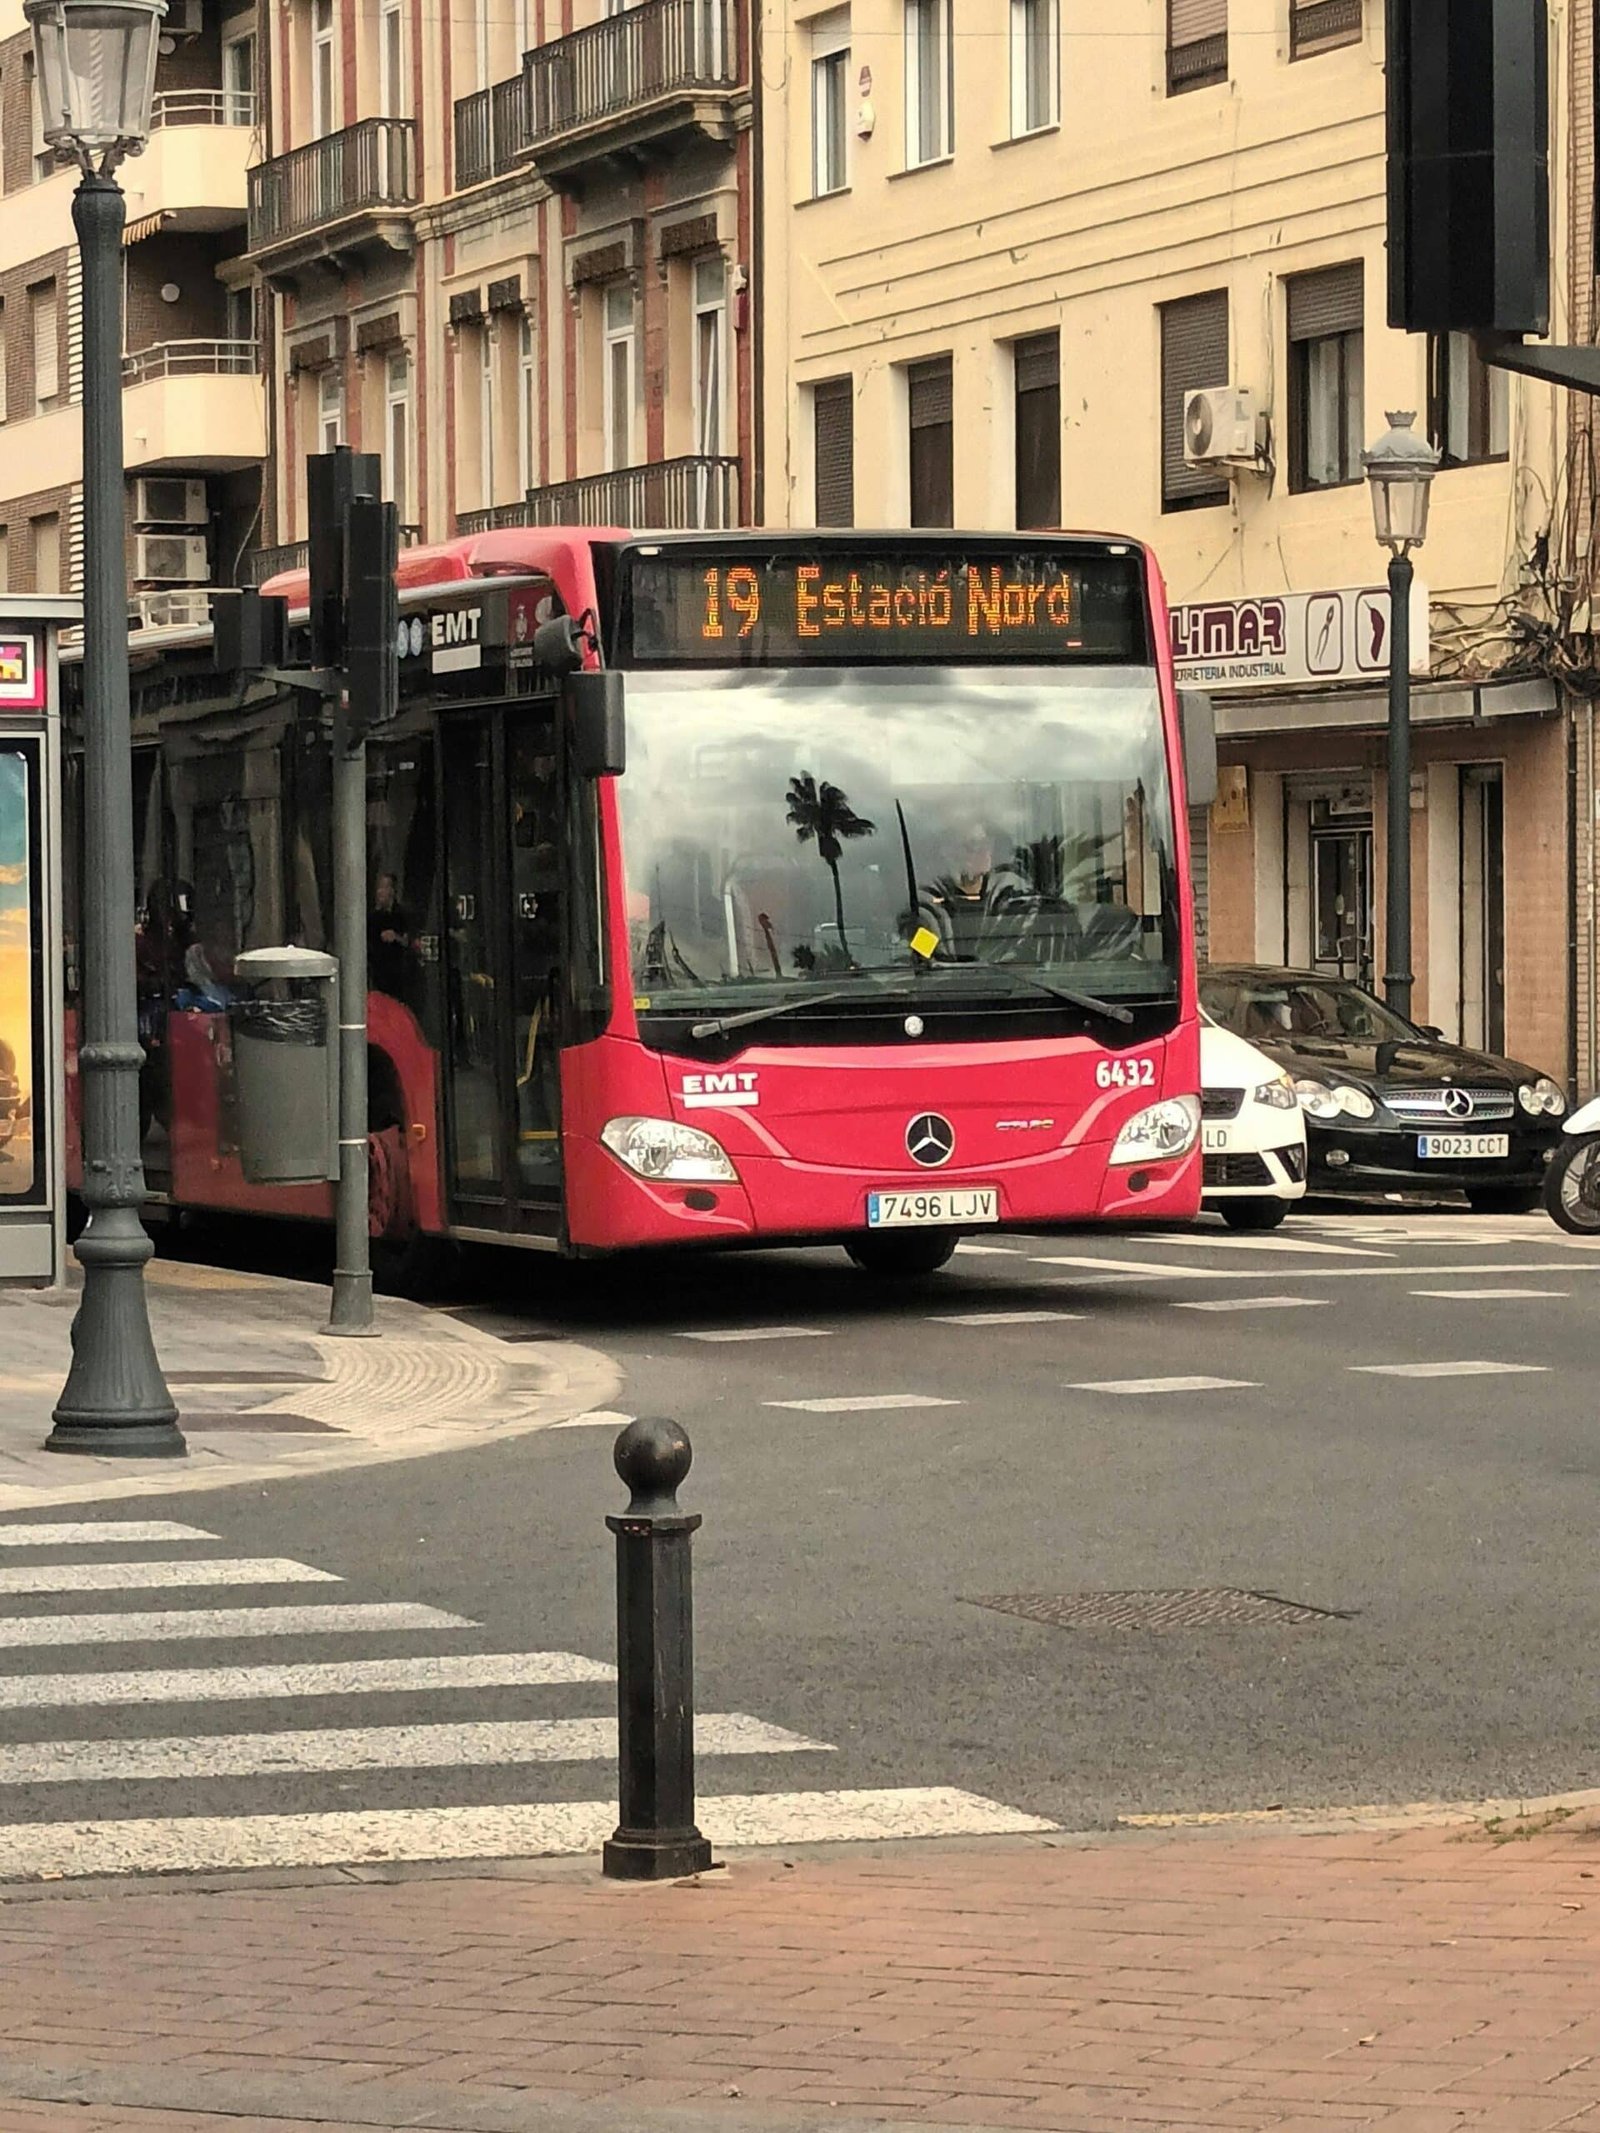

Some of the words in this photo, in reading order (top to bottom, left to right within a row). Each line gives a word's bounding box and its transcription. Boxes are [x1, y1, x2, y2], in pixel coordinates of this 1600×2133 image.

[703, 567, 759, 638] 19
[796, 566, 951, 637] Estació
[967, 566, 1069, 636] Nord
[432, 608, 482, 646] EMT
[1174, 666, 1227, 681] ERRETERIA
[1229, 662, 1287, 678] INDUSTRIAL
[682, 1072, 758, 1093] EMT
[1096, 1059, 1156, 1088] 6432
[1205, 1130, 1227, 1148] LD
[1431, 1138, 1472, 1155] 9023
[1477, 1137, 1504, 1154] CCT
[884, 1196, 942, 1219] 7496
[950, 1193, 992, 1216] LJV
